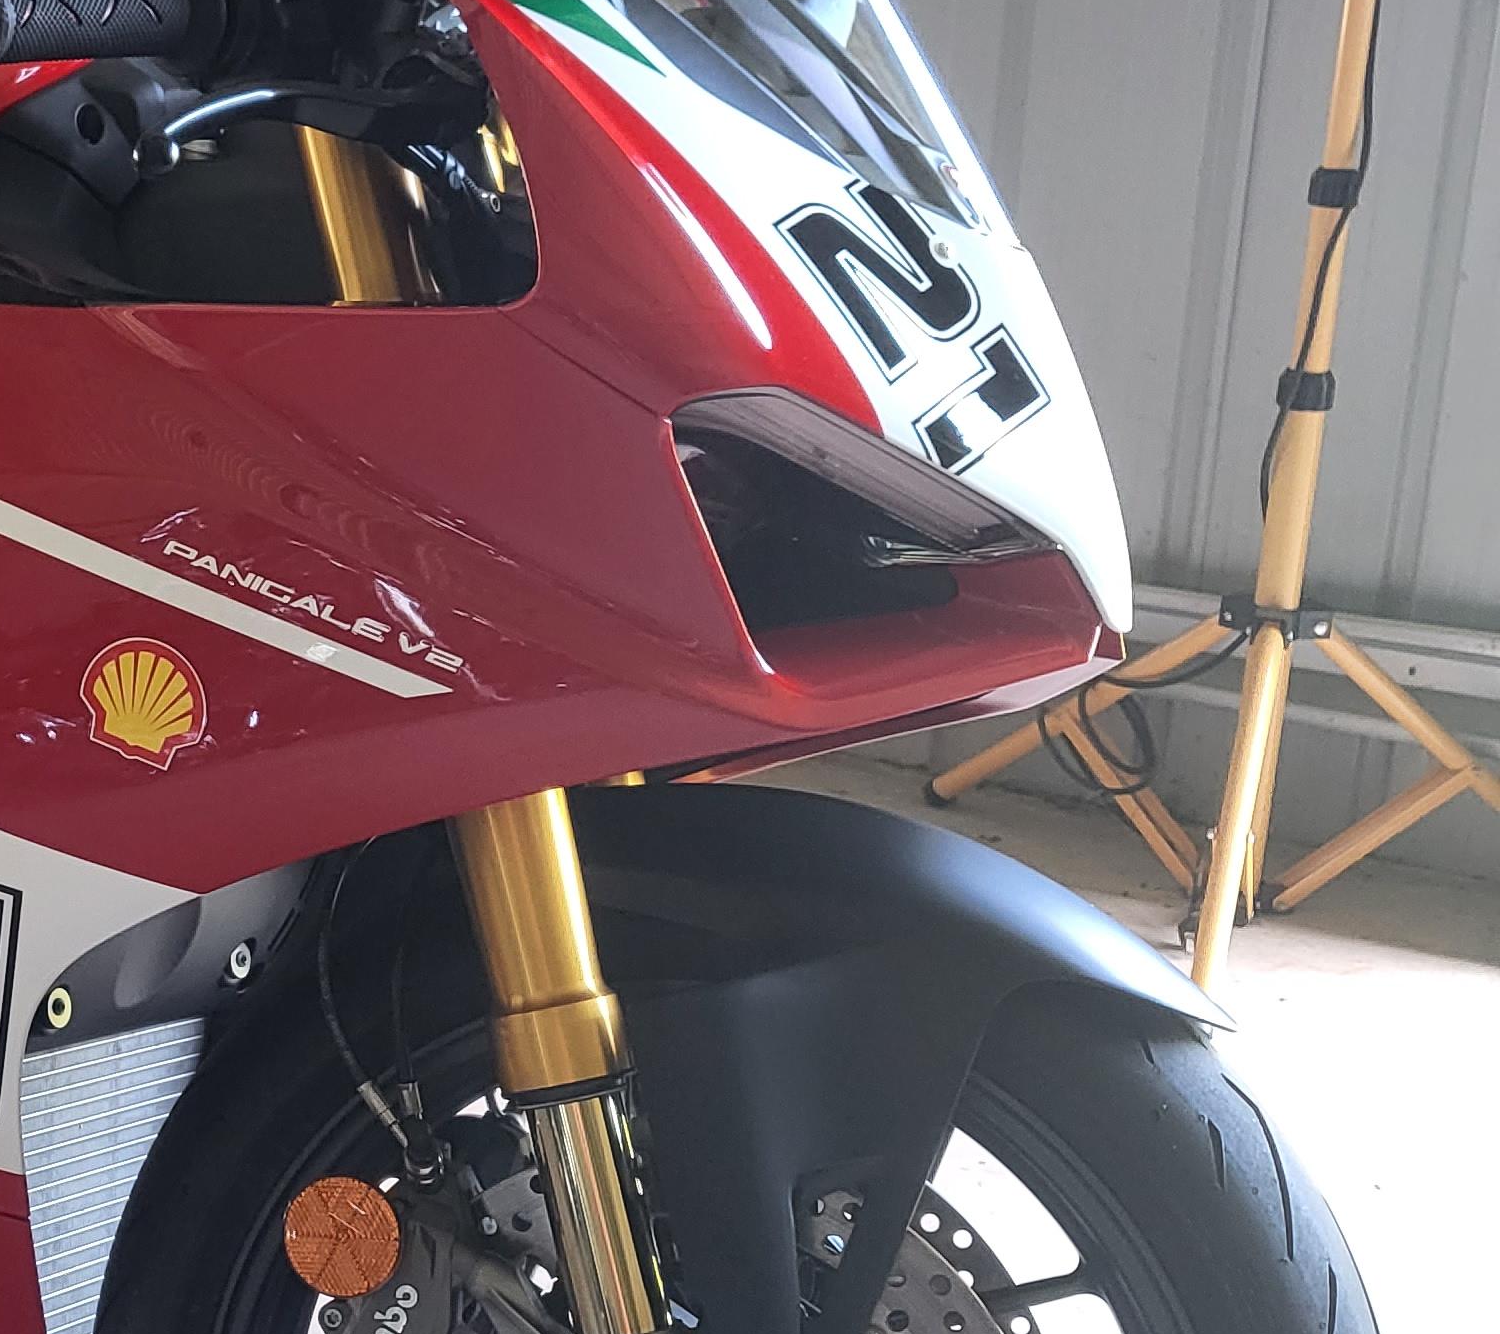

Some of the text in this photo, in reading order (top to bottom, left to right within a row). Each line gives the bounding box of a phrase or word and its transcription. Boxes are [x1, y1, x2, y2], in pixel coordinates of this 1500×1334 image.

[772, 178, 1051, 476] 21
[163, 539, 464, 674] PANIGALE V2
